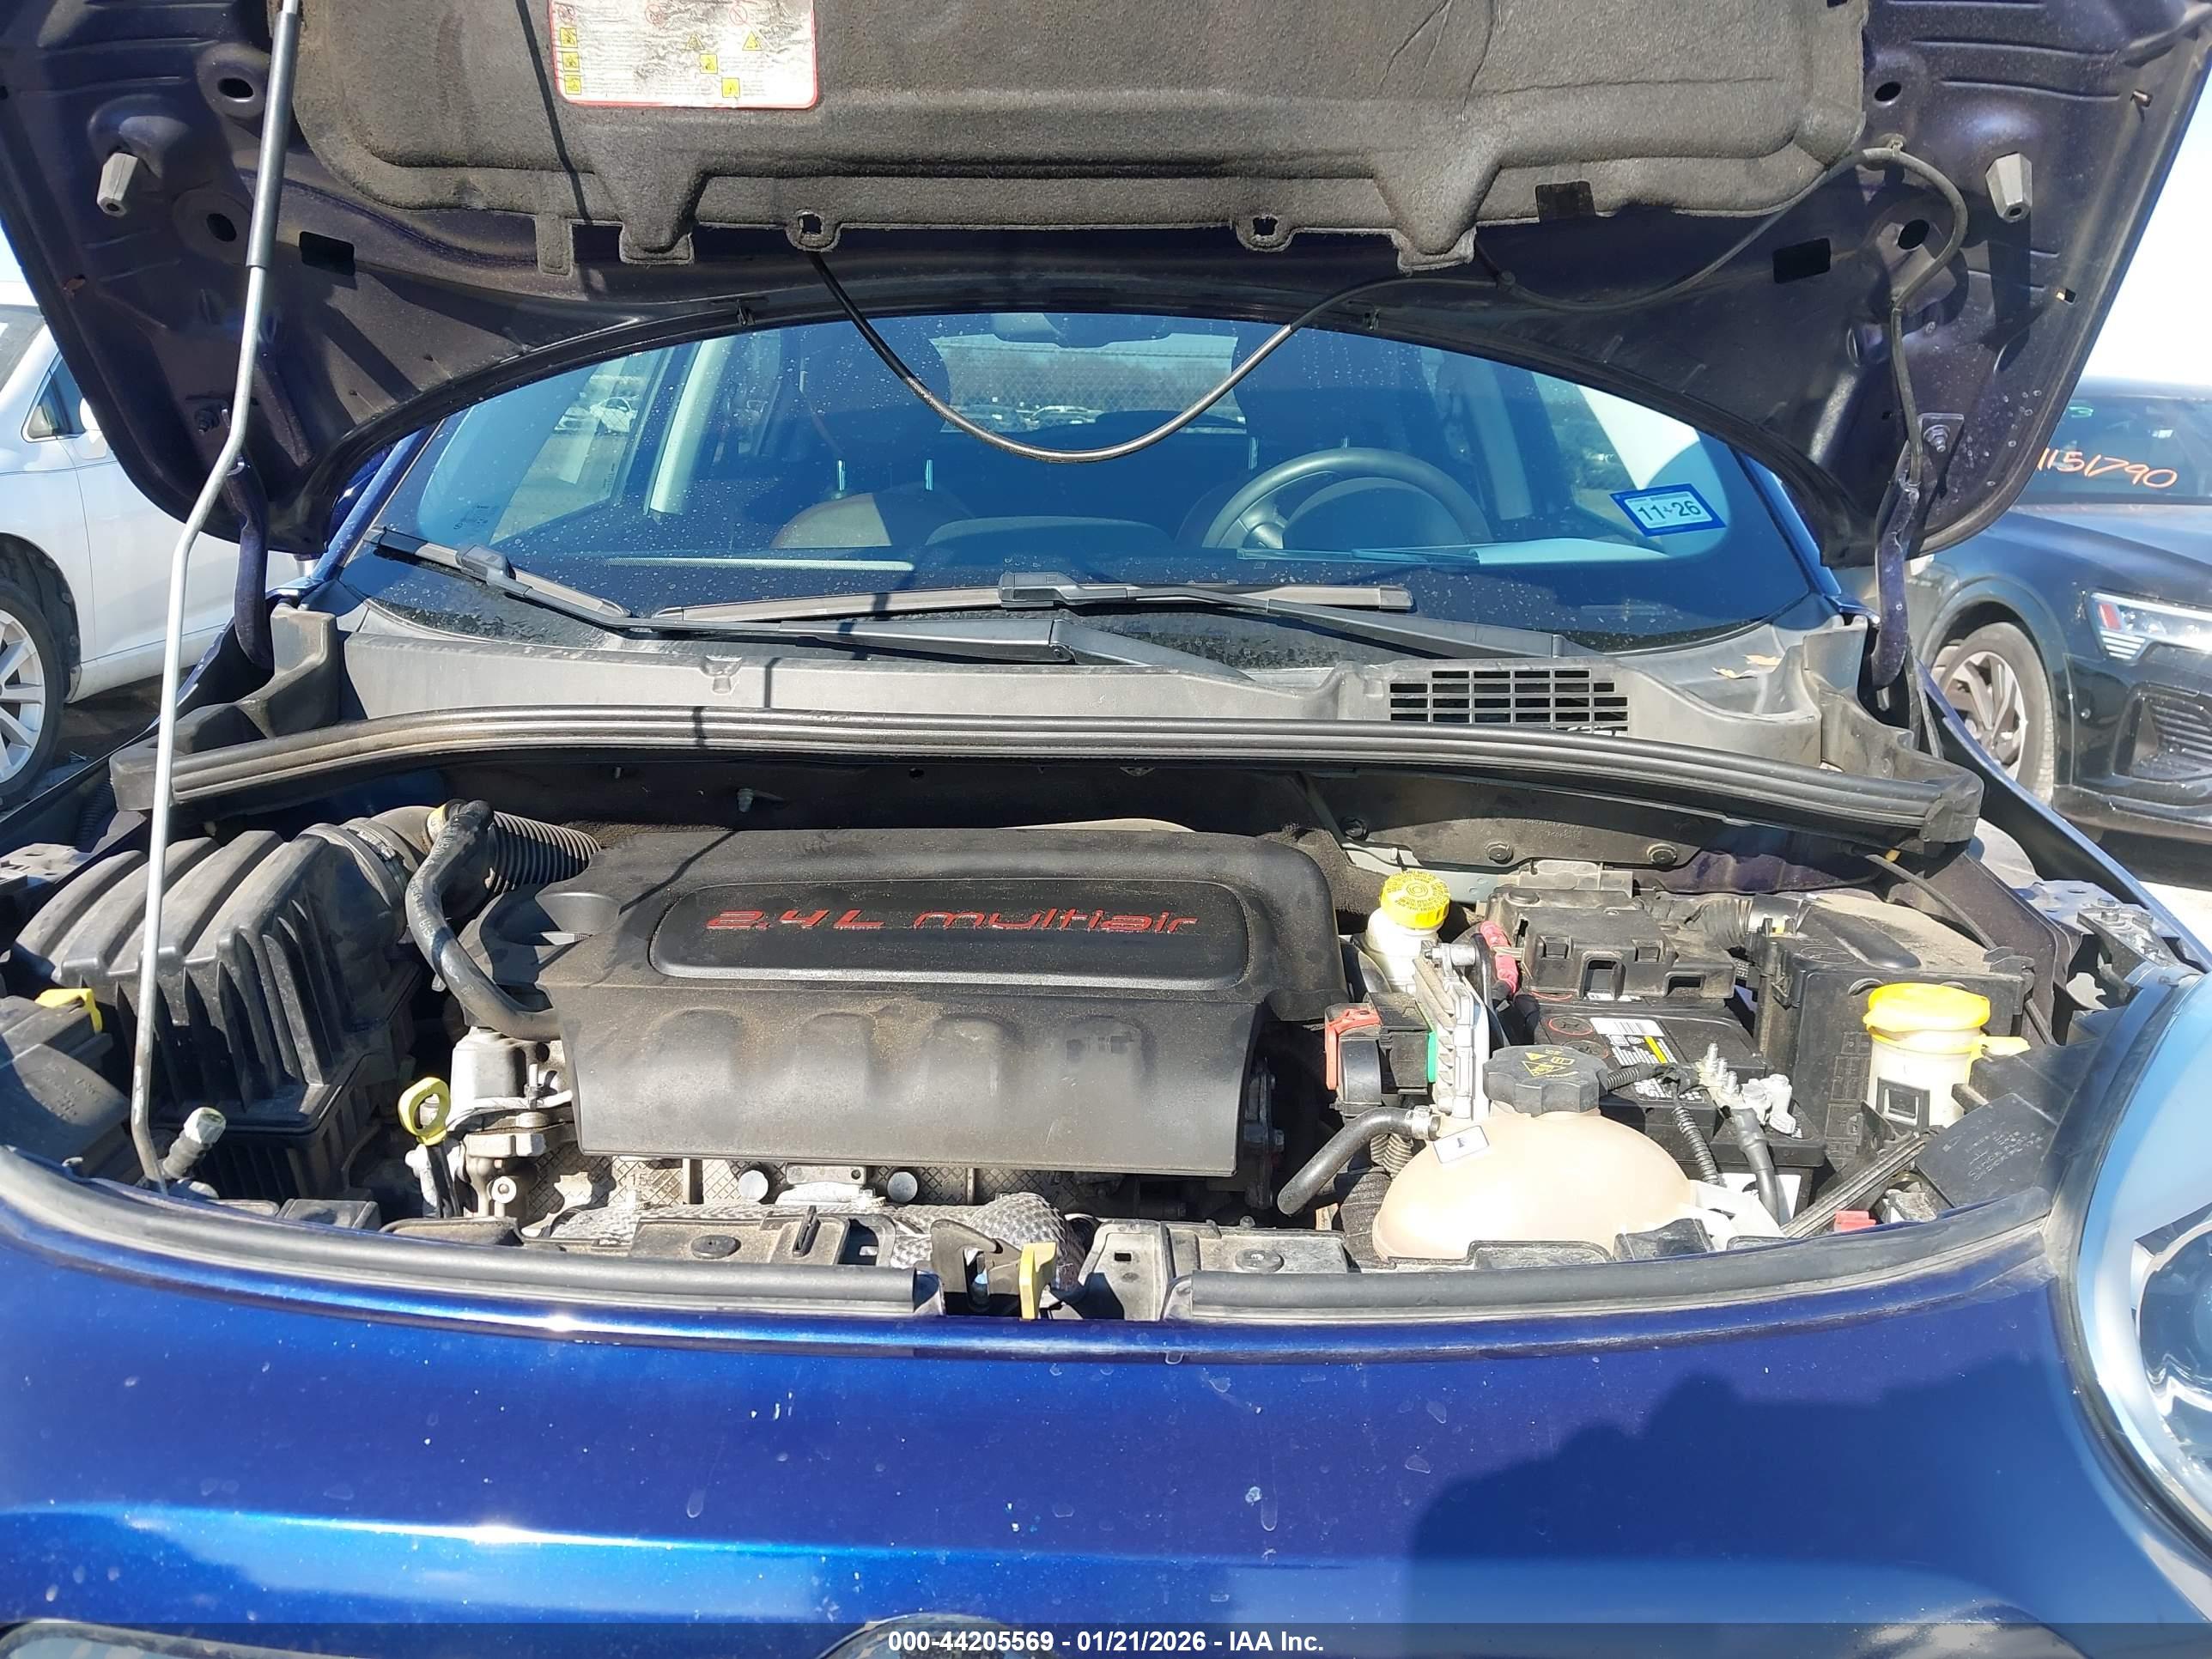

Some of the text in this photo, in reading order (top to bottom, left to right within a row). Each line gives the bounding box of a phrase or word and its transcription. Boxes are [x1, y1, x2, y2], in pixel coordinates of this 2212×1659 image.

[1638, 500, 1702, 521] 11 26
[914, 907, 1197, 933] multiair
